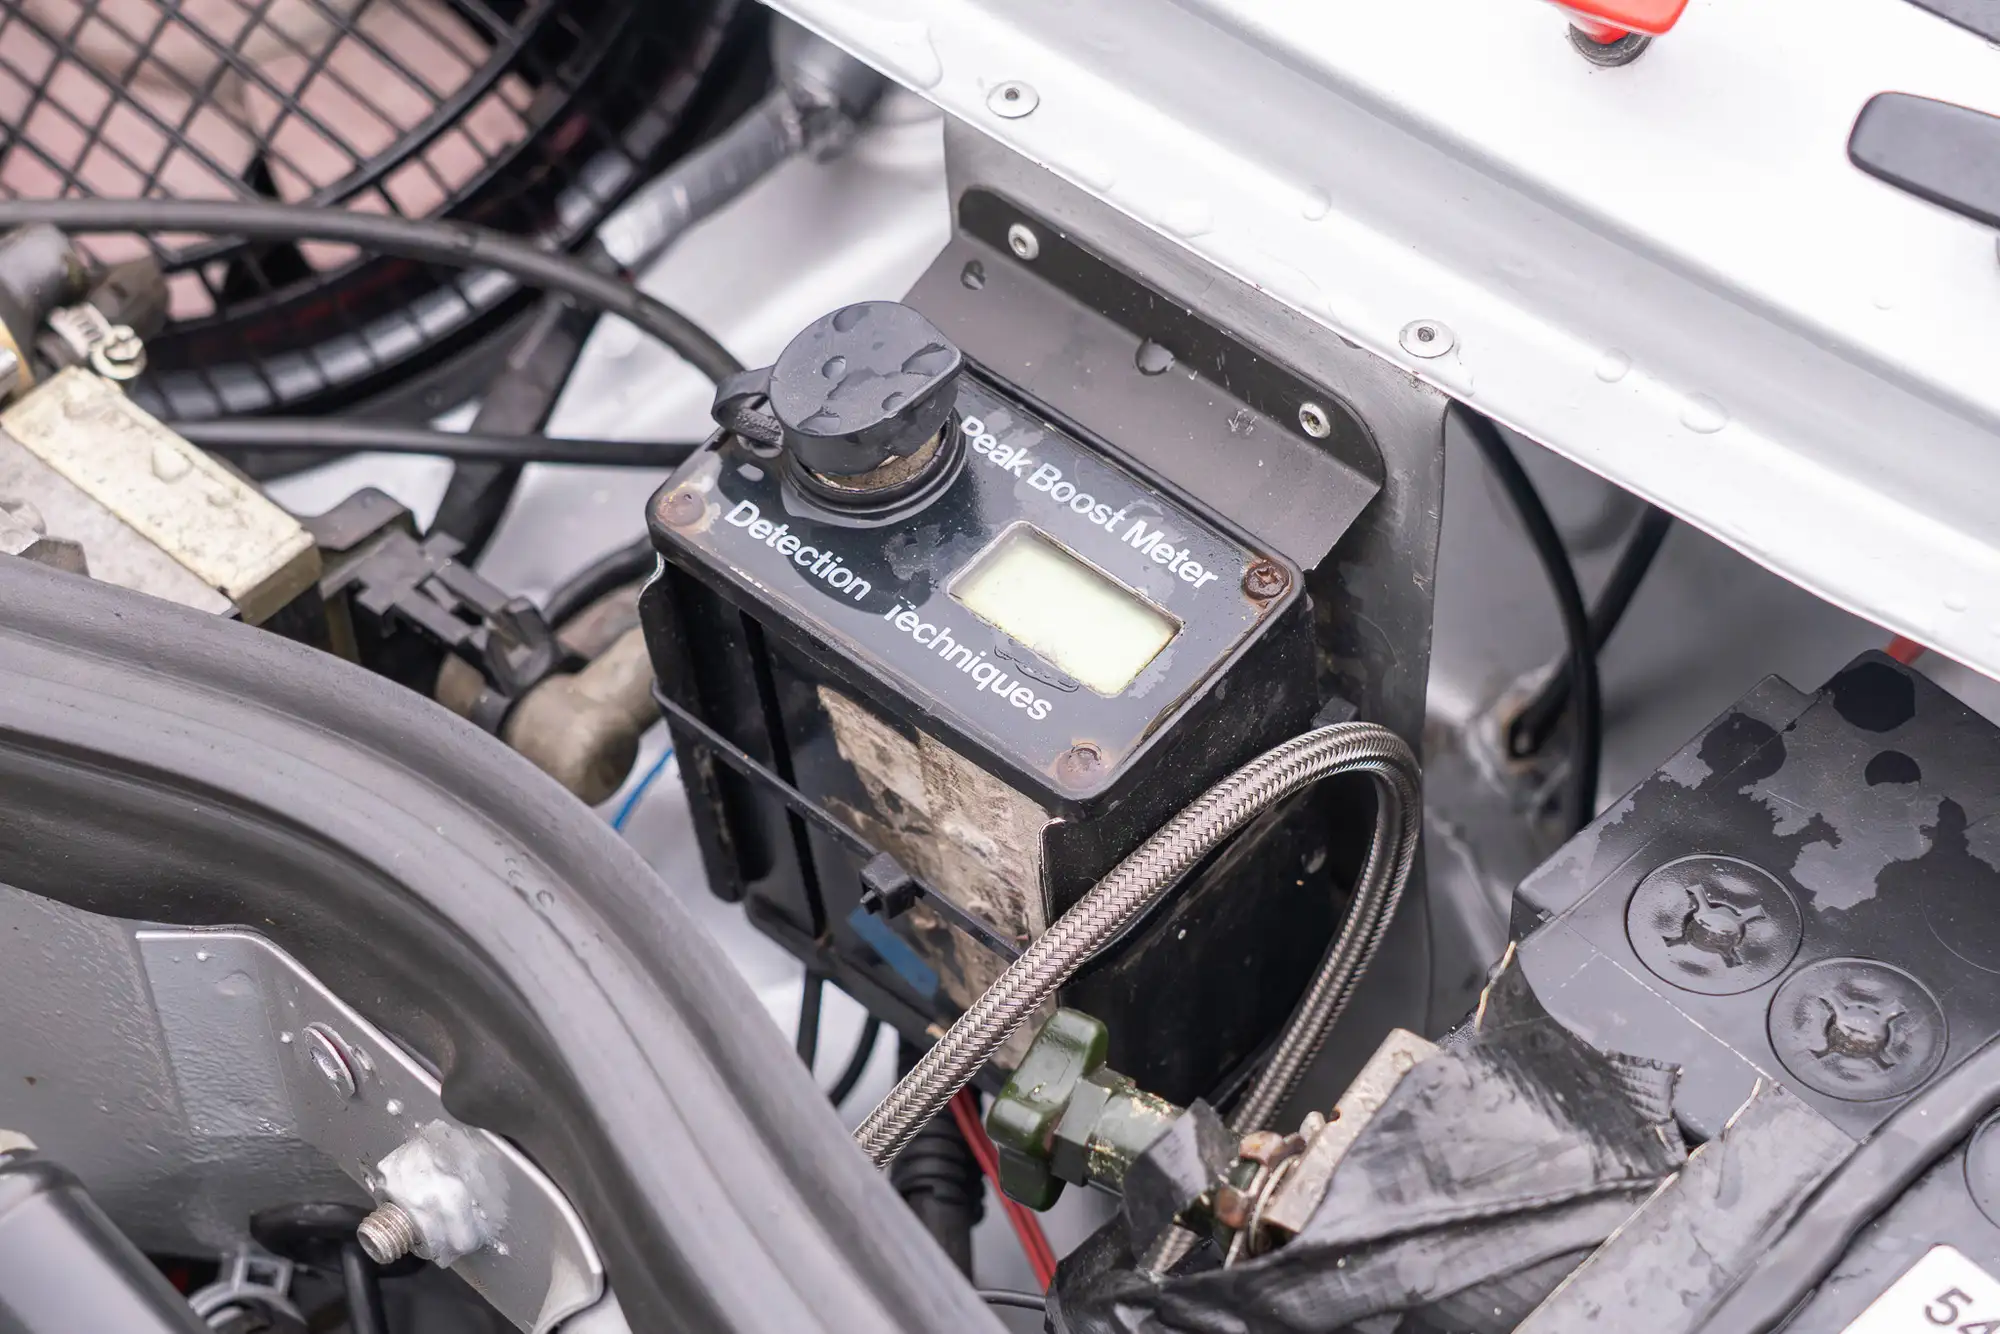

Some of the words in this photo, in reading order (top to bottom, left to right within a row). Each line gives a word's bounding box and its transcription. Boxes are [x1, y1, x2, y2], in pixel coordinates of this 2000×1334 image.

[961, 415, 1033, 478] Peak
[1026, 462, 1127, 533] Boost
[1121, 519, 1219, 589] Meter
[724, 499, 872, 601] Detection
[883, 595, 1053, 720] Techniques
